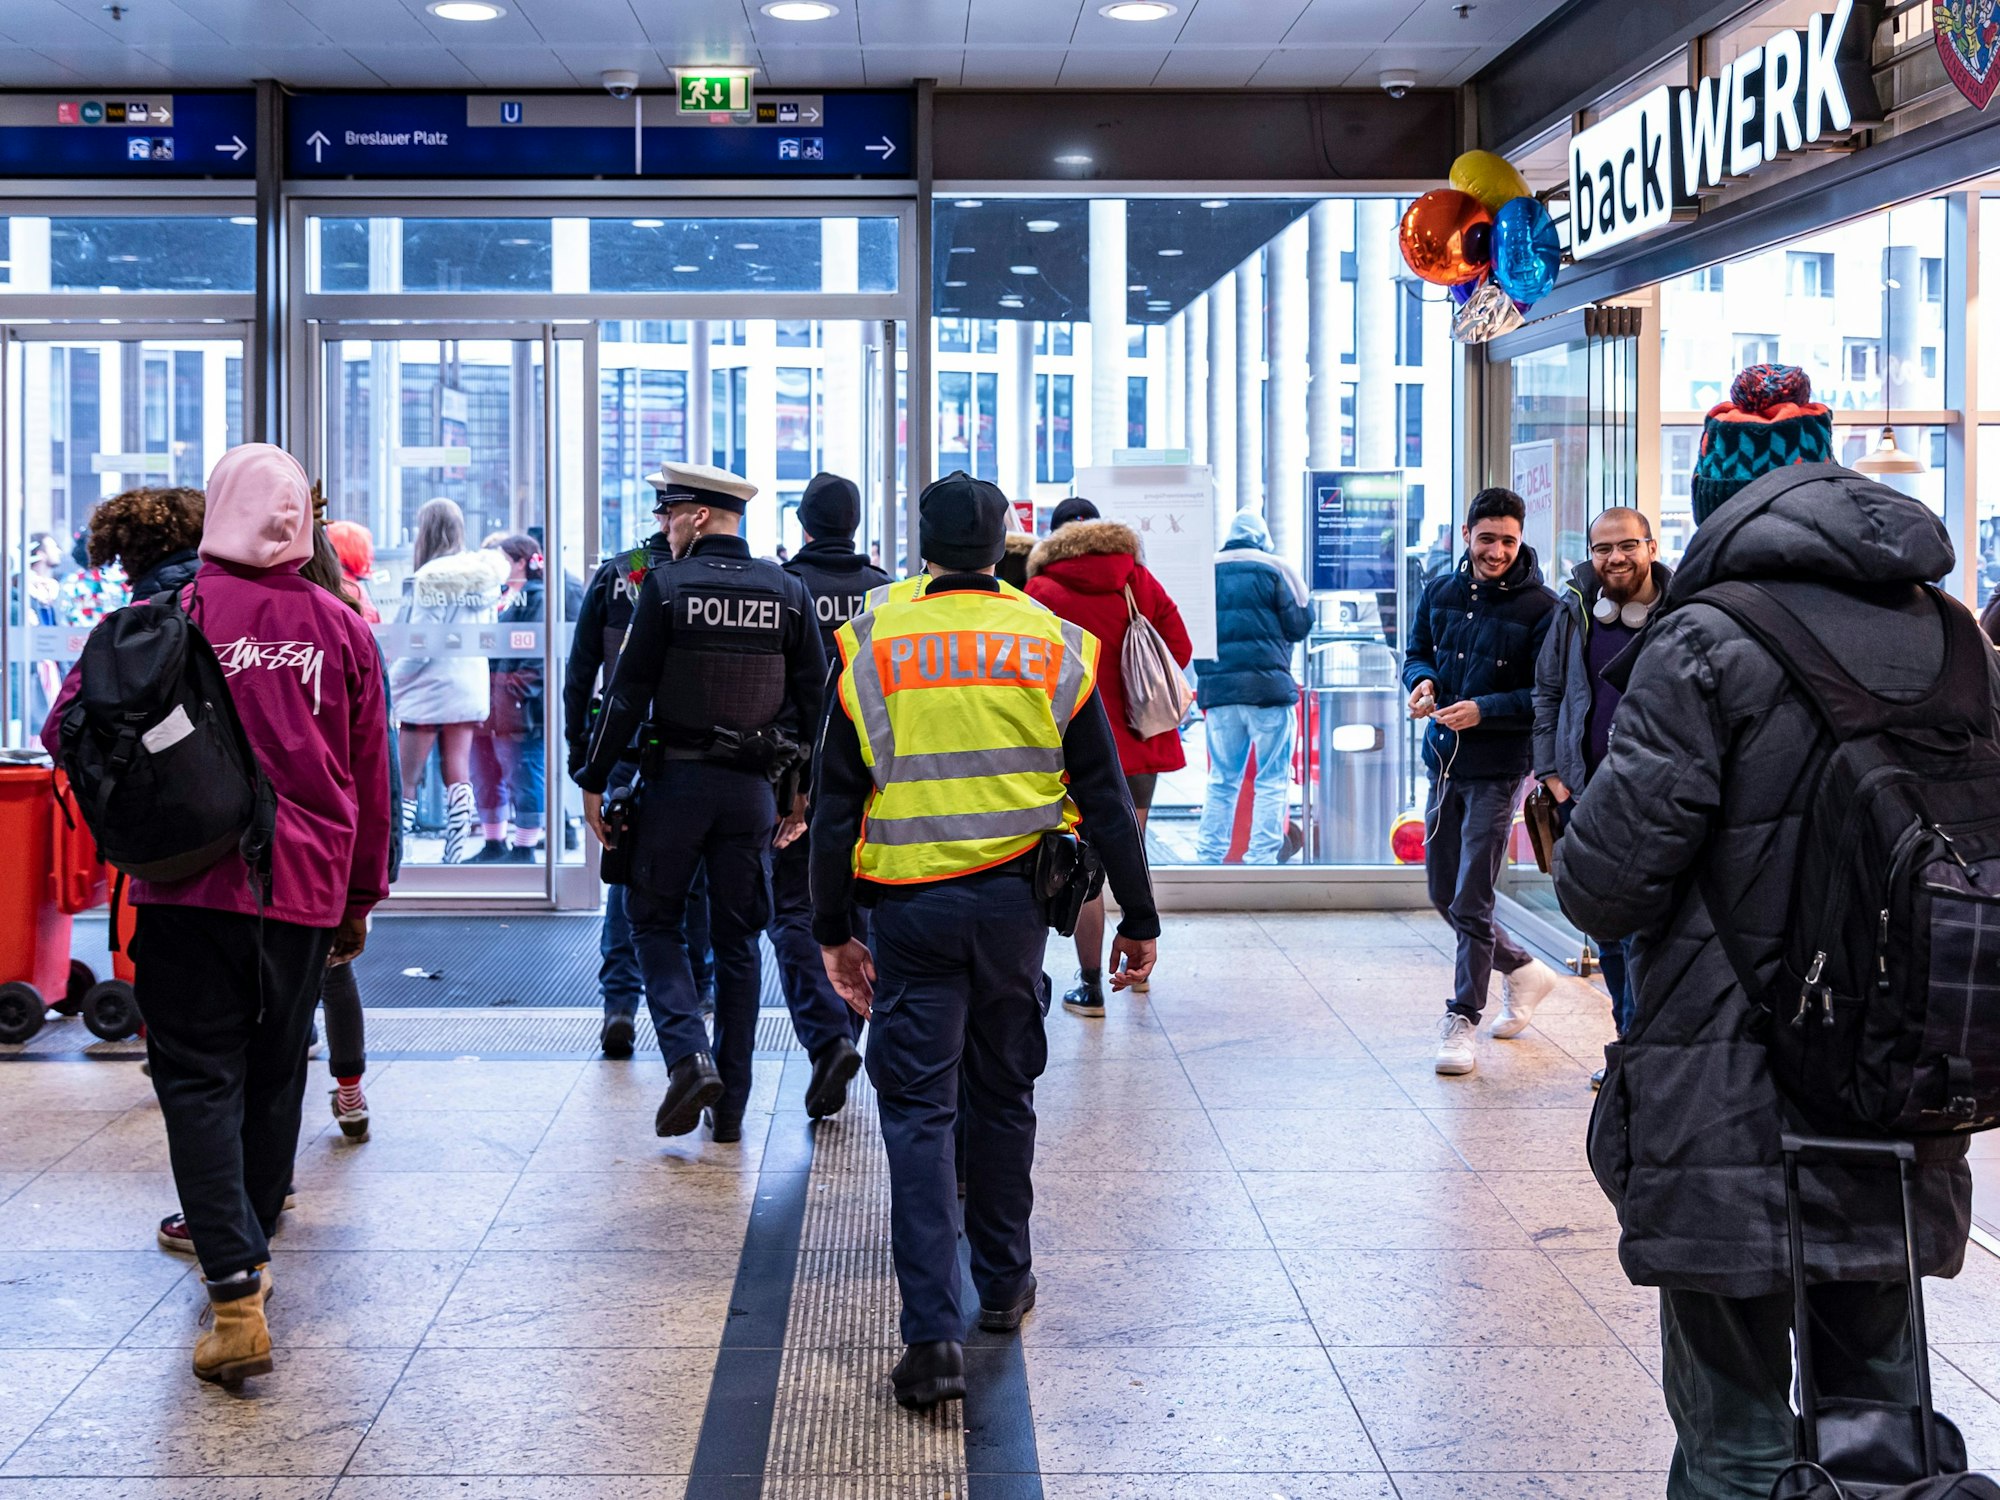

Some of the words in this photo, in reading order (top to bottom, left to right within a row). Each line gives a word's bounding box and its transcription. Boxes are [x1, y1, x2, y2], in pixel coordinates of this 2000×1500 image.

[504, 103, 519, 123] U
[758, 108, 776, 117] TAXI
[1576, 109, 1664, 246] back
[1679, 0, 1853, 197] WERK
[345, 130, 411, 146] Breslauer
[413, 130, 449, 146] Platz
[1526, 463, 1551, 496] DEAL
[687, 596, 781, 629] POLIZEI
[811, 595, 864, 622] OLIZ
